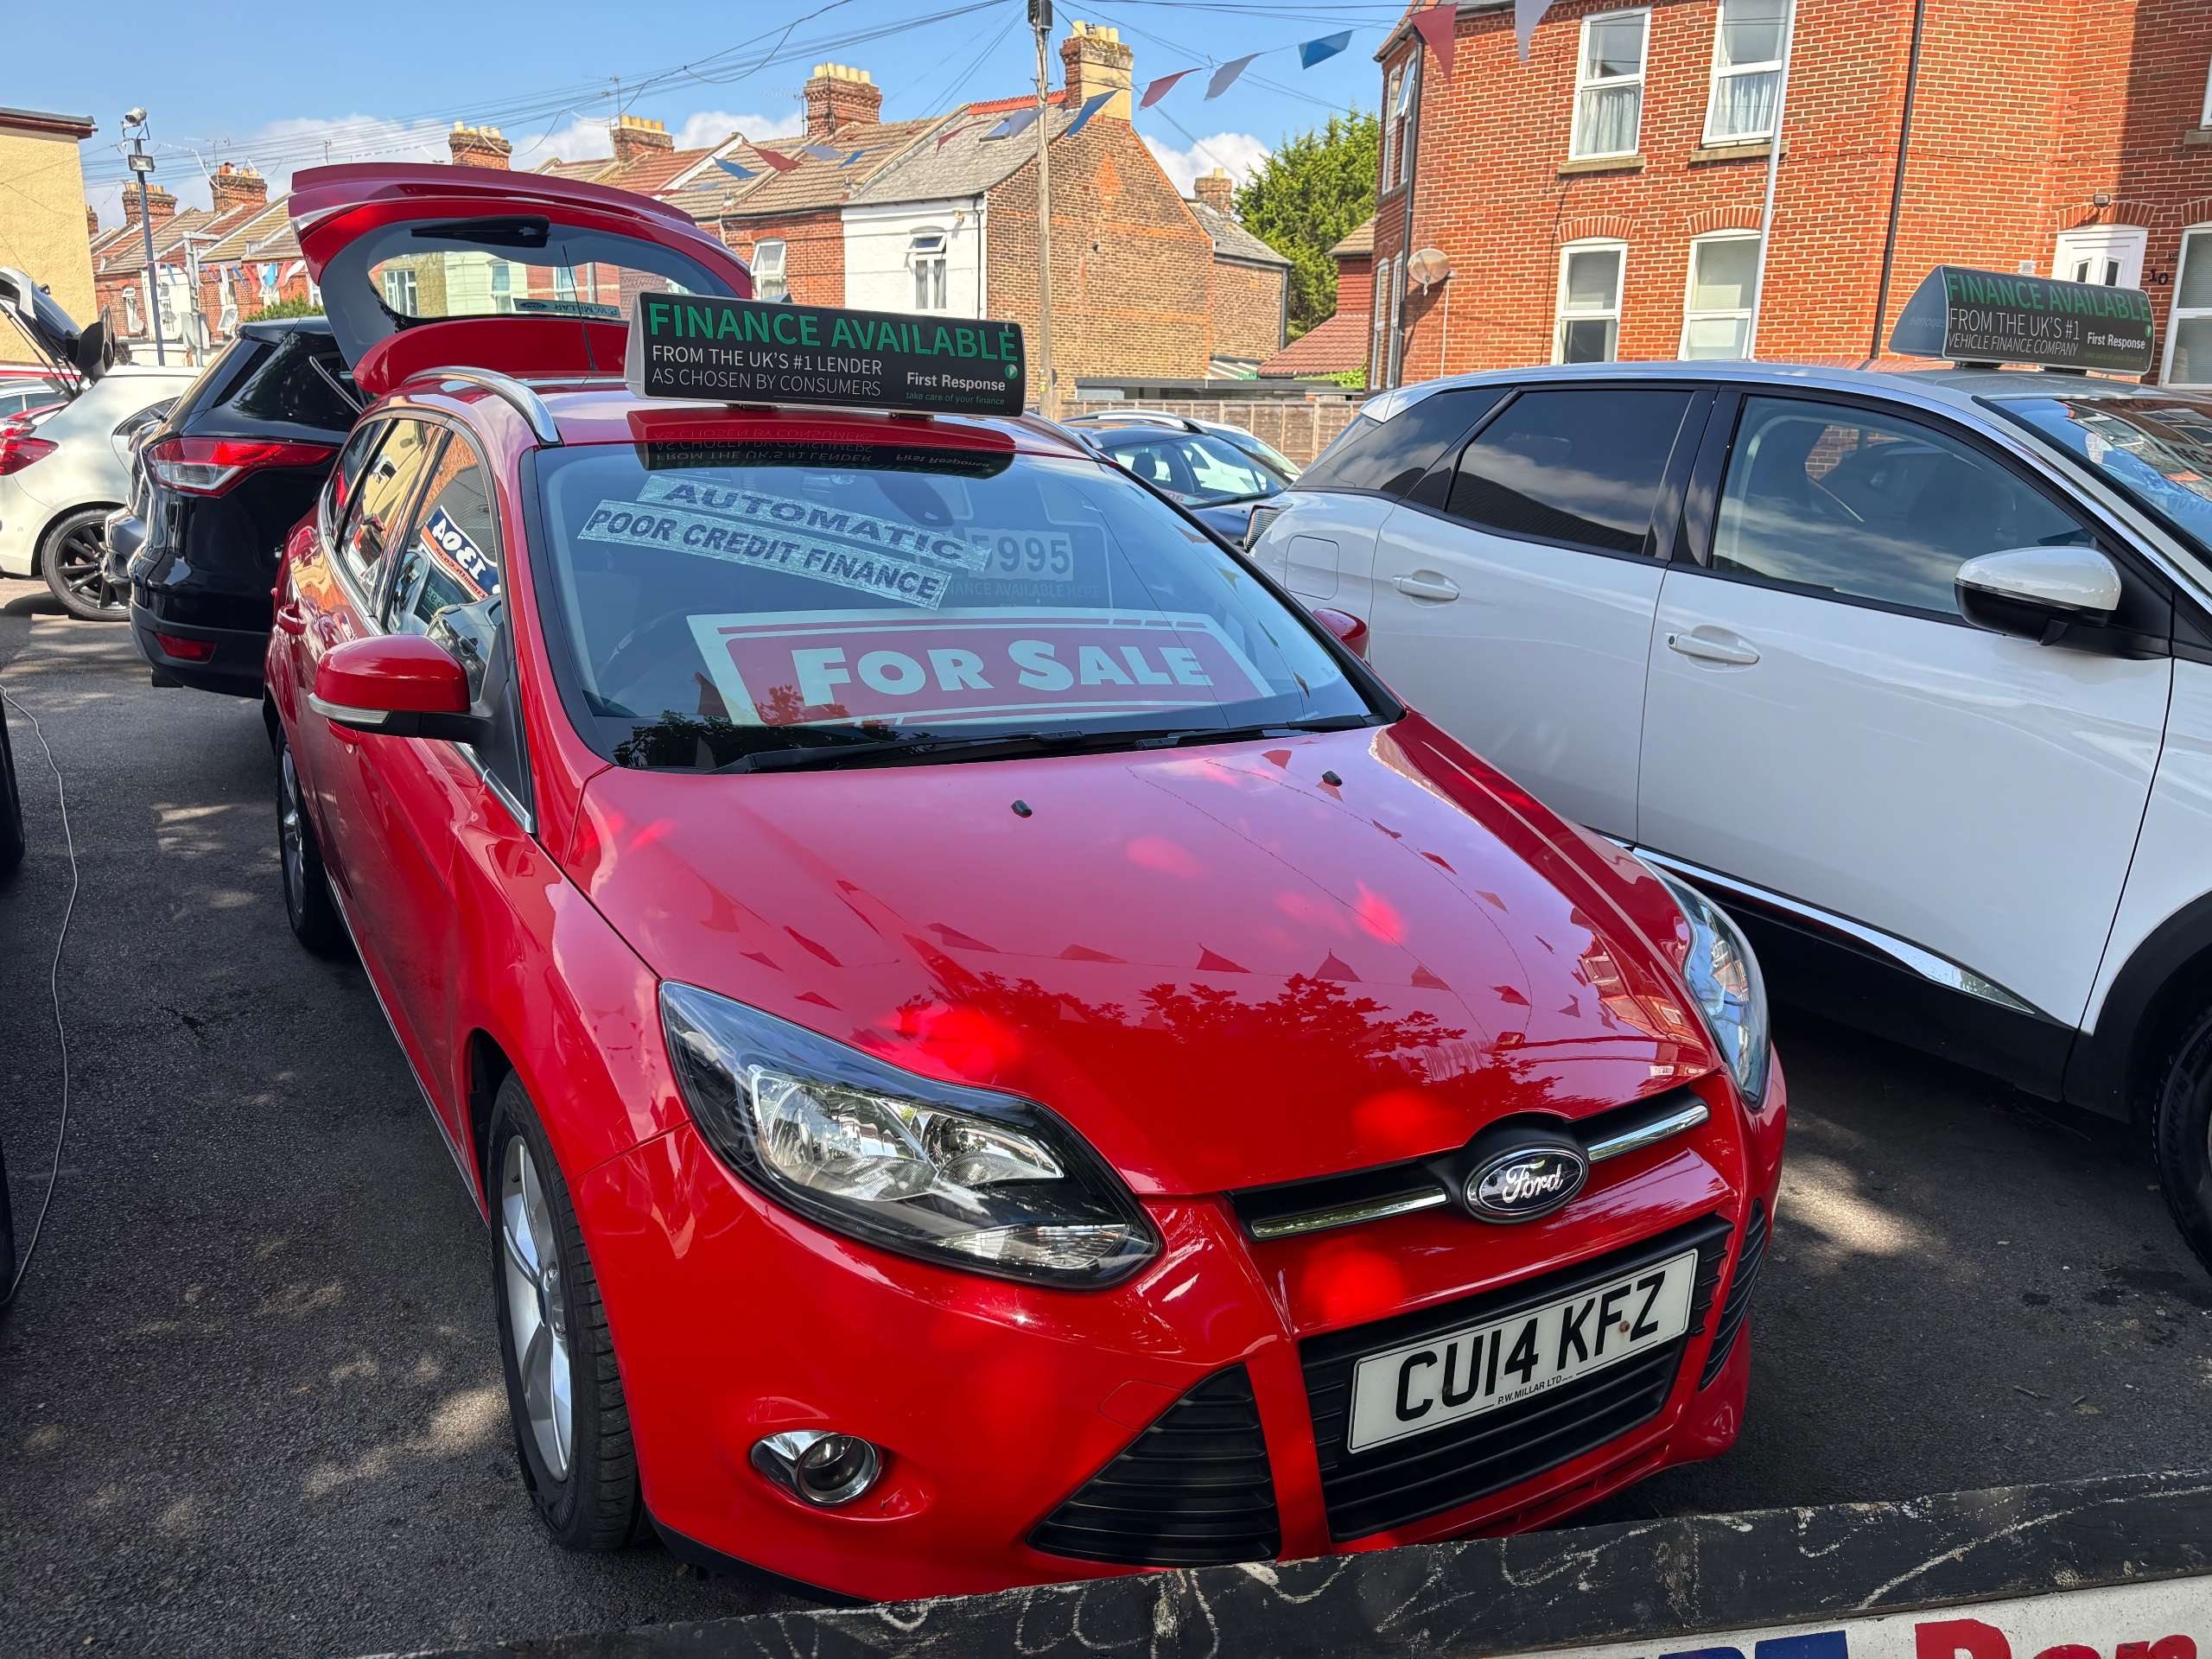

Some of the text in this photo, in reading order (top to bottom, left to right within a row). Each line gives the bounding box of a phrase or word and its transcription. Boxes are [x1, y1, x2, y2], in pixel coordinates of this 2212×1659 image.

[2149, 268, 2169, 285] 10
[1945, 272, 2152, 322] FINANCE AVAILABLE
[649, 302, 1018, 361] FINANCE AVAILABLE
[1948, 308, 1993, 333] FROM
[1996, 311, 2025, 335] THE
[2030, 315, 2062, 339] UK'S
[2065, 320, 2080, 340] #1
[1948, 333, 2080, 357] VEHICLE FINANCE COMPANY
[2087, 331, 2145, 351] First Response
[652, 345, 882, 376] FROM THE UK'S #1 LENDER
[652, 367, 881, 397] AS CHOSEN BY CONSUMERS
[906, 372, 1006, 392] First Response
[906, 391, 924, 401] take
[944, 393, 954, 402] of
[976, 395, 1005, 405] finance
[663, 484, 964, 560] AUTOMATIC
[585, 509, 939, 600] POOR CREDIT FINANCE
[995, 582, 1064, 597] AVAILABLE
[1066, 585, 1100, 598] HERE
[791, 639, 1214, 707] FOR SALE
[1502, 1159, 1565, 1204] Ford
[1395, 1269, 1666, 1421] CU14 KFZ
[1547, 1375, 1562, 1387] LTD
